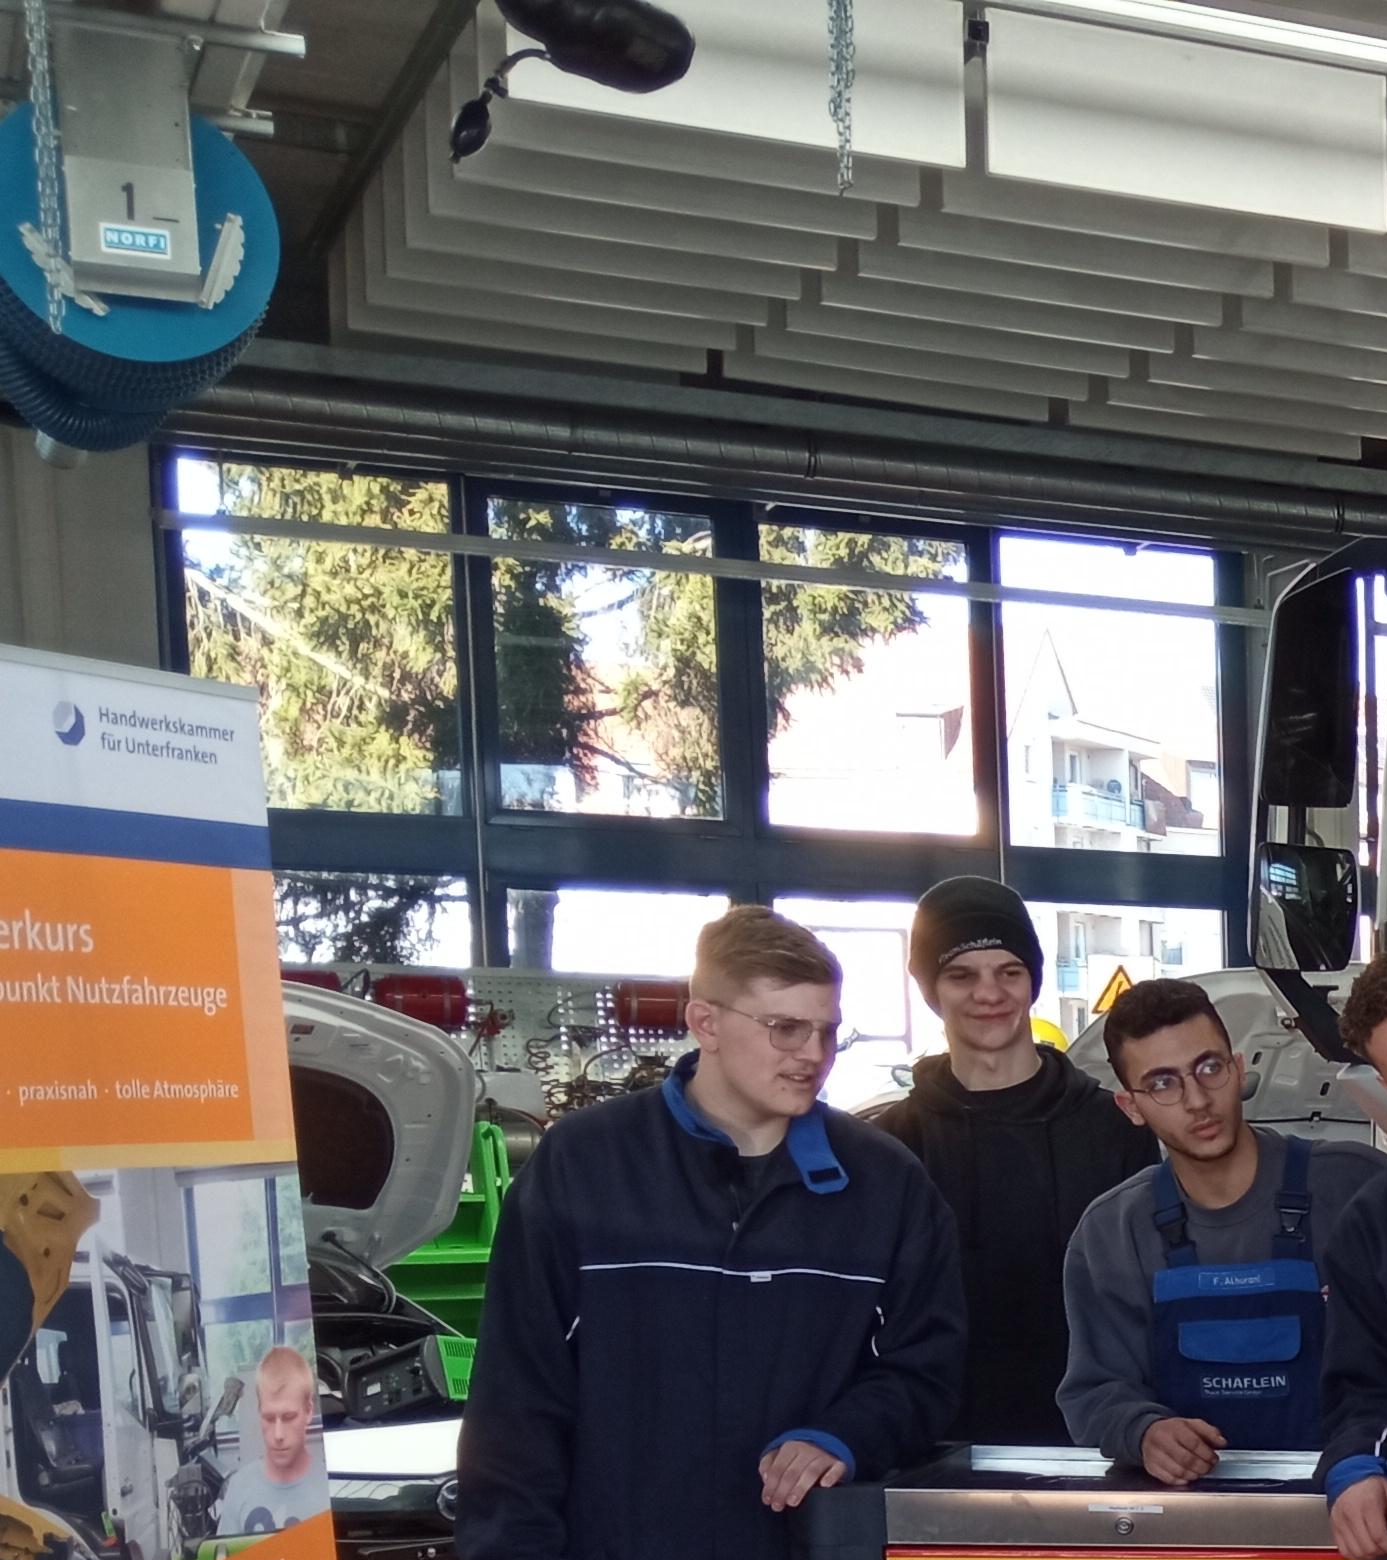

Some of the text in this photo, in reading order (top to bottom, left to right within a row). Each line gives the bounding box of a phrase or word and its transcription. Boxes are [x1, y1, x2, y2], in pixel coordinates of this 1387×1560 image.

[121, 181, 135, 221] 1
[104, 229, 167, 251] NORFI
[98, 706, 235, 743] Handwerkskammer
[101, 732, 218, 765] für Unterfranken
[66, 975, 228, 1016] Nutzfahrzeuge
[18, 1078, 240, 1107] praxisnah tolle Atmosphäre
